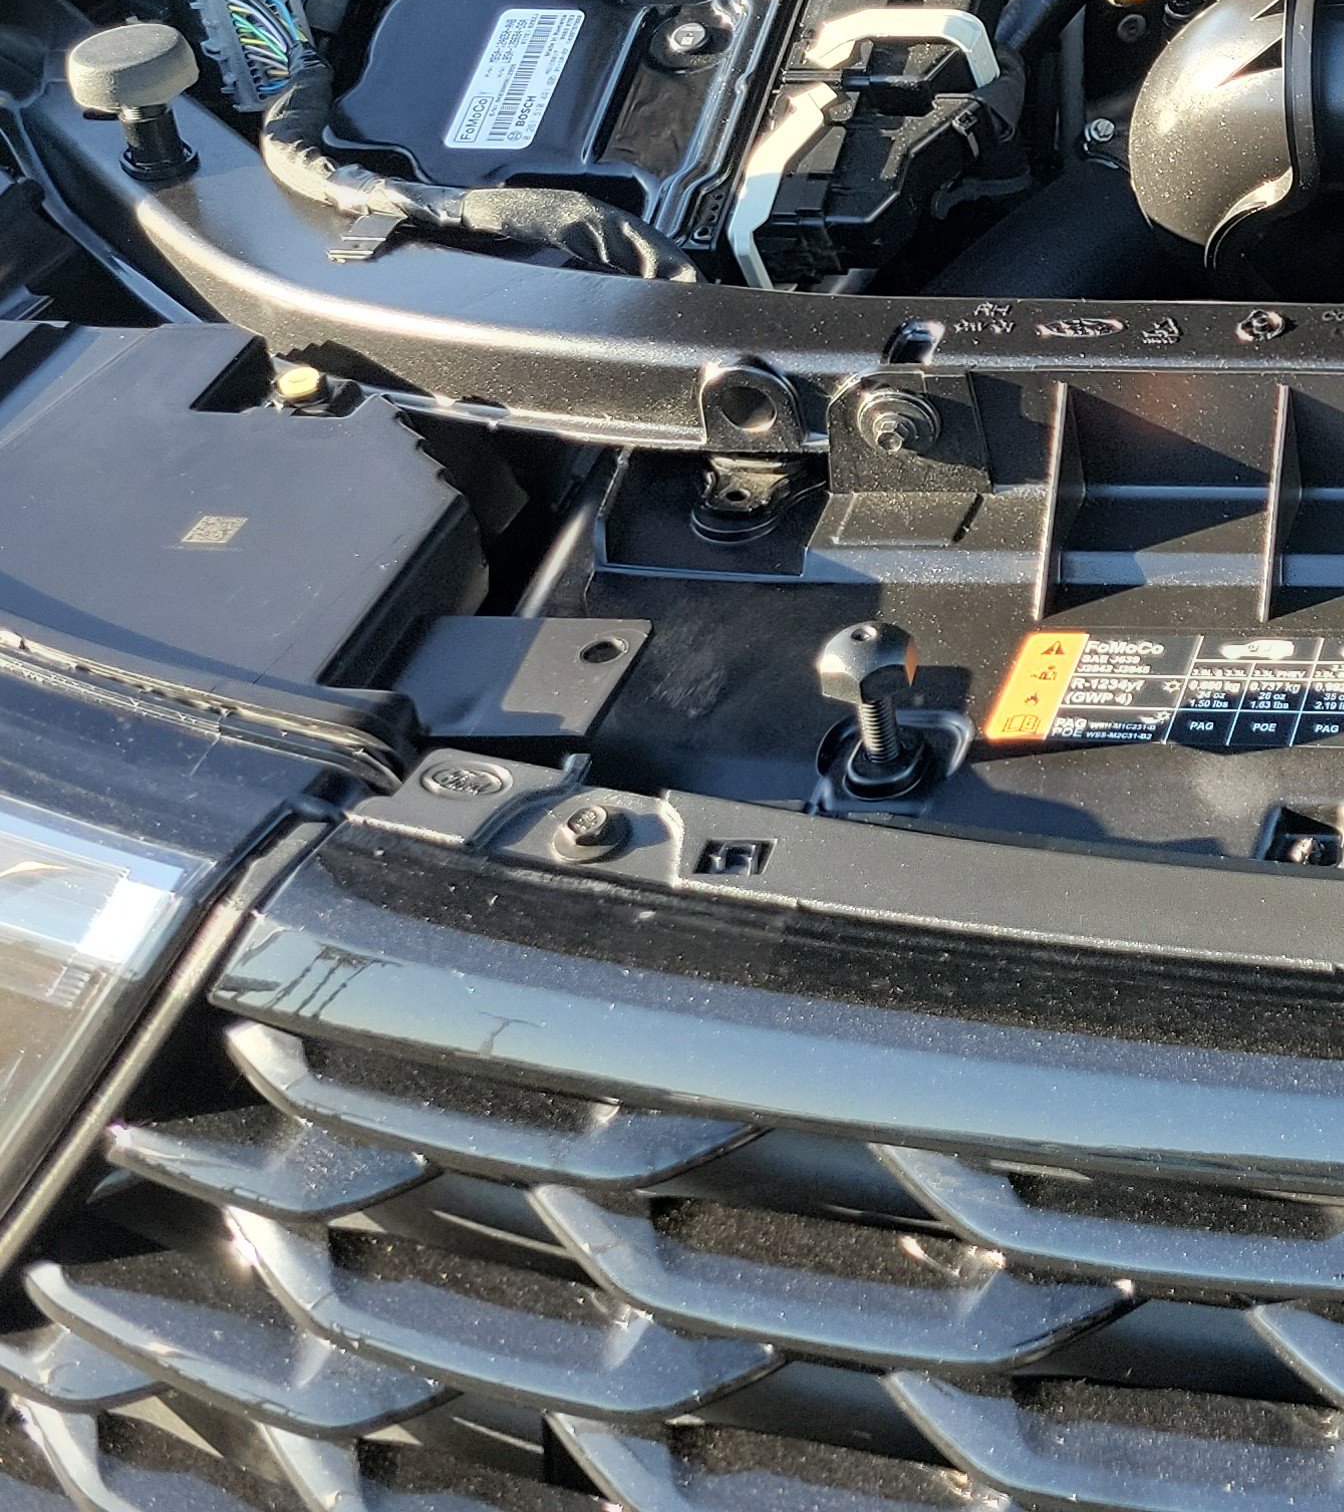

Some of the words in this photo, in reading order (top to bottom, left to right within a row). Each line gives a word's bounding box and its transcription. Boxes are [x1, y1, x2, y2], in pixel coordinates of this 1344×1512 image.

[515, 95, 537, 127] BOSCH
[461, 98, 488, 141] FoMoCo
[1084, 639, 1166, 655] FoMoCo
[1070, 677, 1146, 692] R-1234yf
[1224, 680, 1241, 693] kg
[1249, 680, 1285, 692] 0.737
[1285, 682, 1301, 694] kg
[1064, 691, 1114, 705] (GWP
[1114, 691, 1133, 706] 4)
[1212, 692, 1227, 700] oz
[1273, 693, 1287, 701] oz
[1323, 693, 1339, 701] 35
[1189, 699, 1211, 708] 1.50
[1211, 699, 1229, 709] lbs
[1272, 700, 1290, 710] lbs
[1314, 701, 1337, 710] 2.19
[1054, 717, 1088, 729] PAG
[1189, 720, 1214, 731] PAG
[1251, 722, 1277, 733] POE
[1050, 727, 1084, 738] POE
[1314, 724, 1340, 734] PAG
